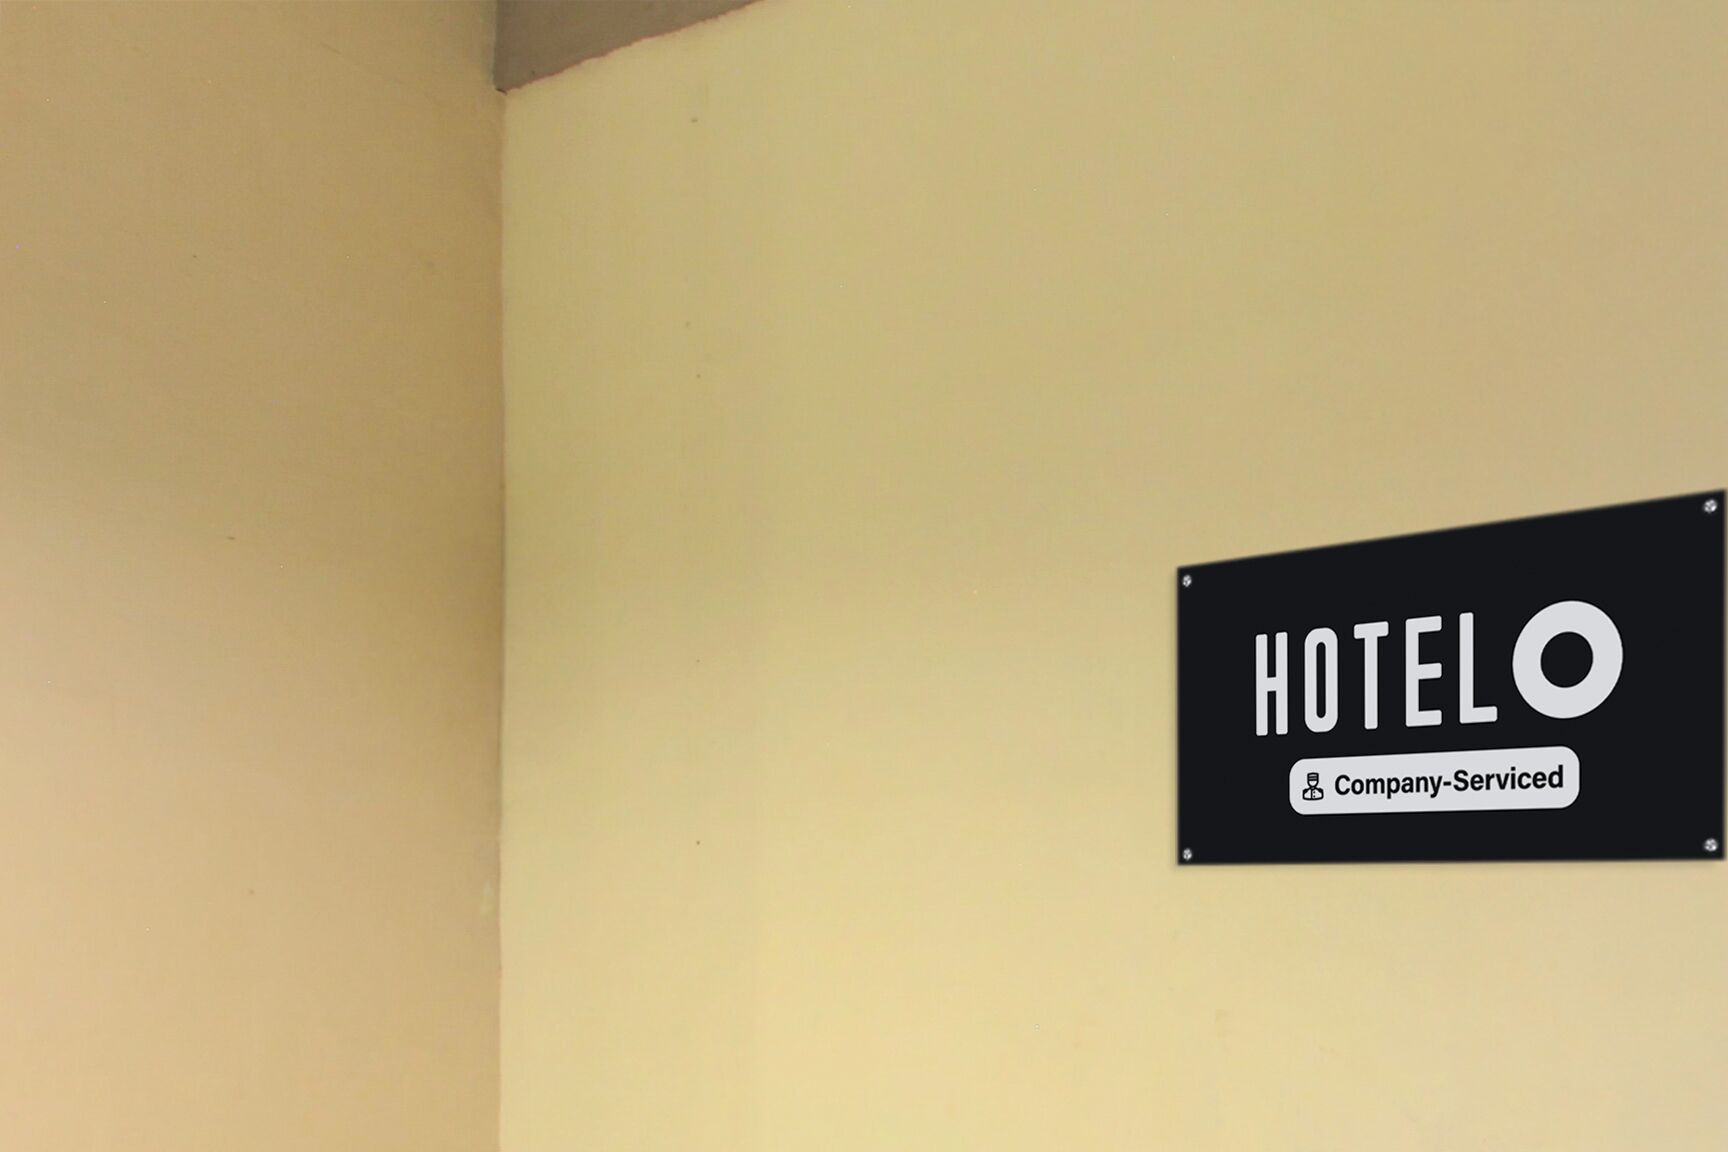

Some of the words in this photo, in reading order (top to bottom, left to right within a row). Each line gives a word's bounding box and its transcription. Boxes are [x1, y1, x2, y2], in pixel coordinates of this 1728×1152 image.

[1255, 612, 1498, 737] HOTEL
[1512, 600, 1624, 719] O
[1334, 764, 1564, 800] Company-Serviced
